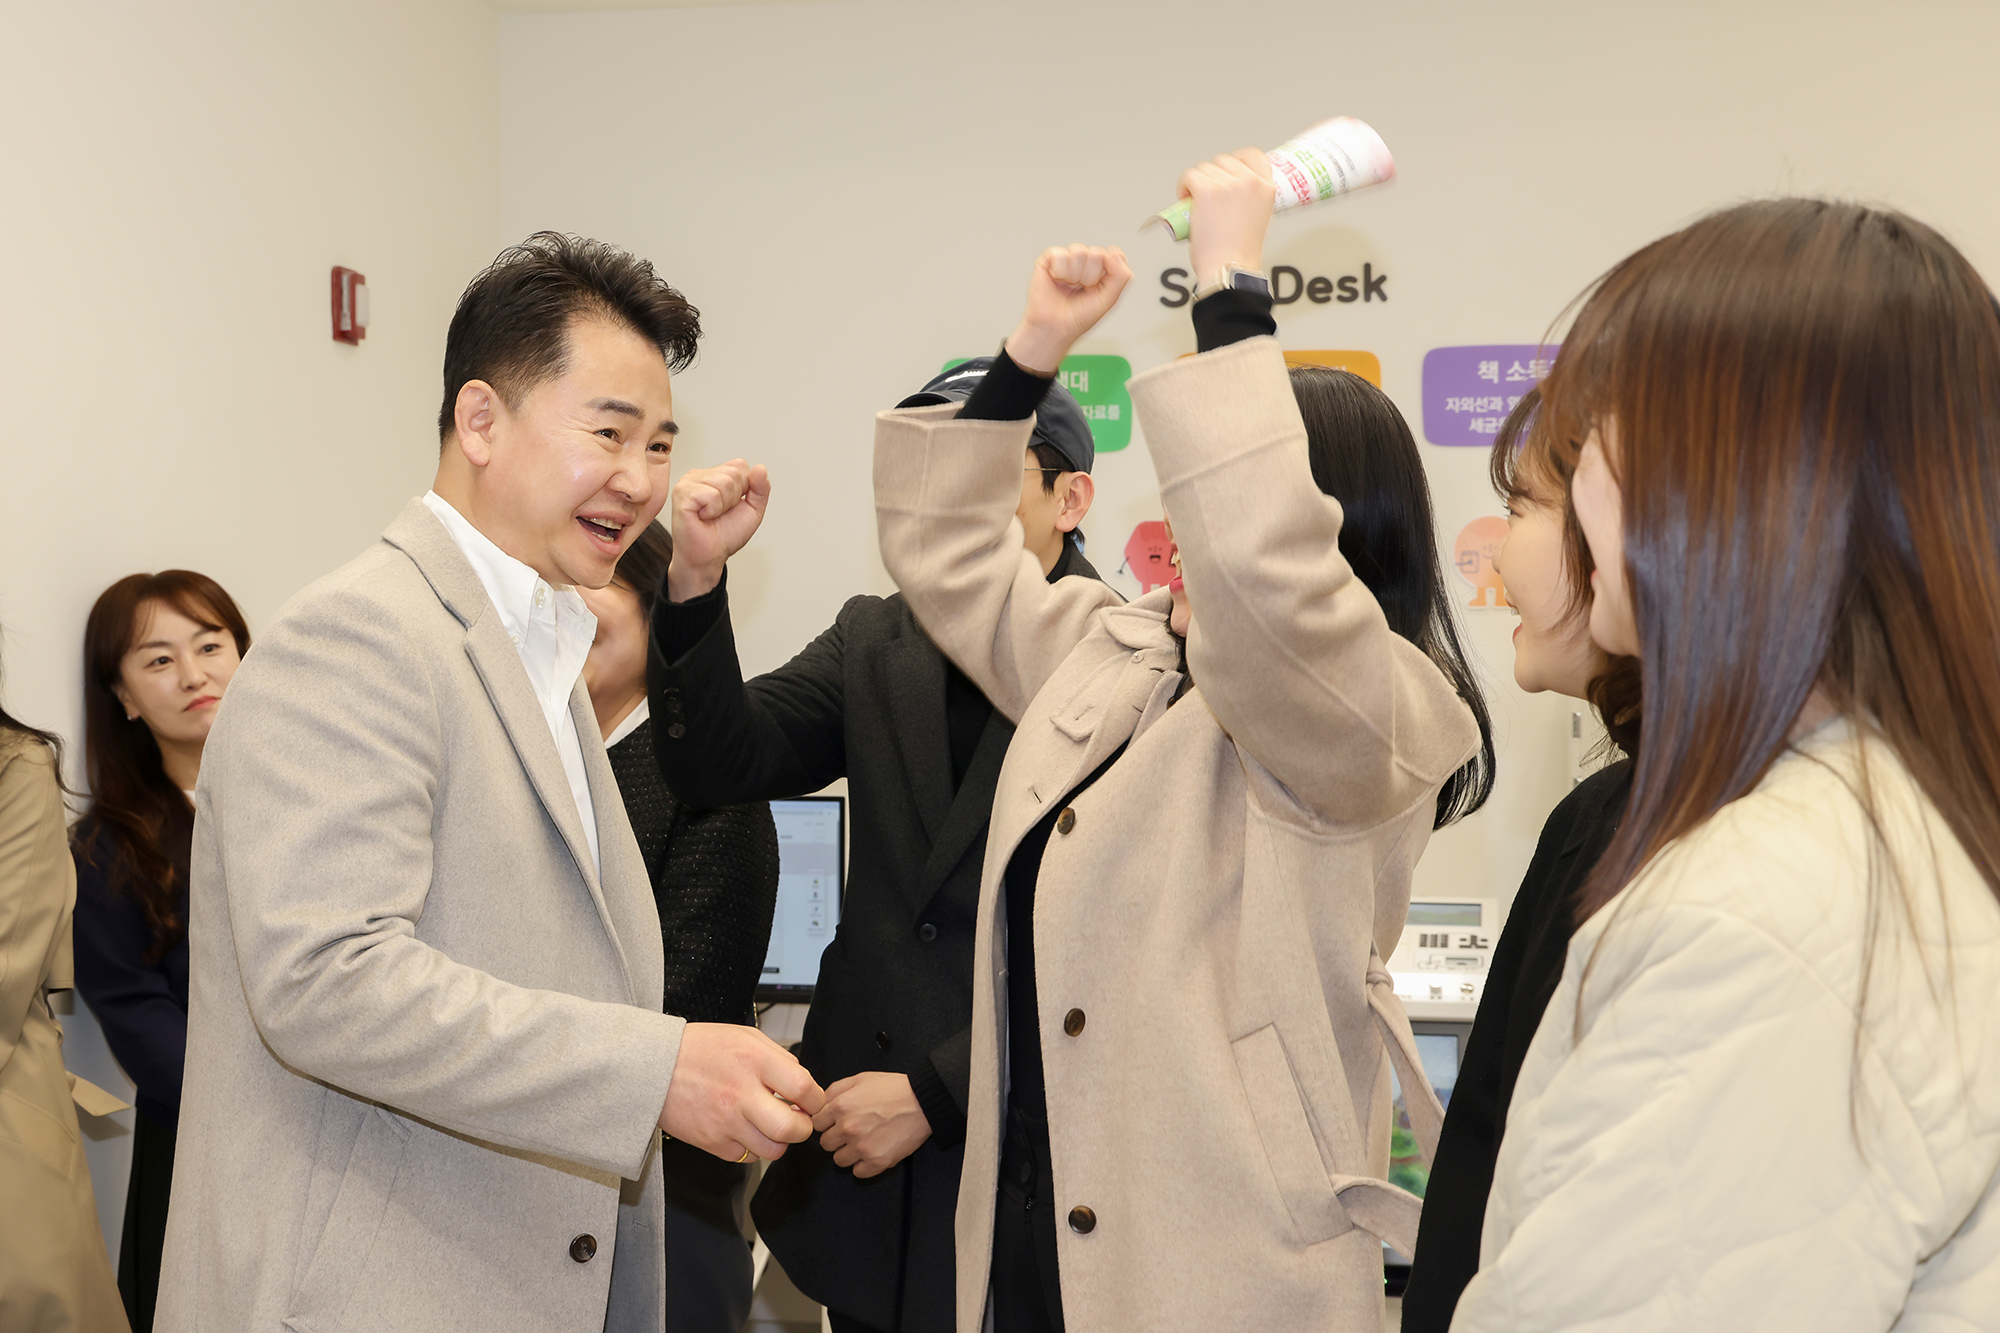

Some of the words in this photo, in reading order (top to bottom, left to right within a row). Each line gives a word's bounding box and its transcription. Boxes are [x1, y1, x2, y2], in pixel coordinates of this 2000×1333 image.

[1271, 263, 1388, 304] Desk
[1477, 360, 1499, 384] 책
[1505, 360, 1556, 381] 소독
[1082, 404, 1121, 420] 자료를
[1445, 396, 1503, 413] 자외선과
